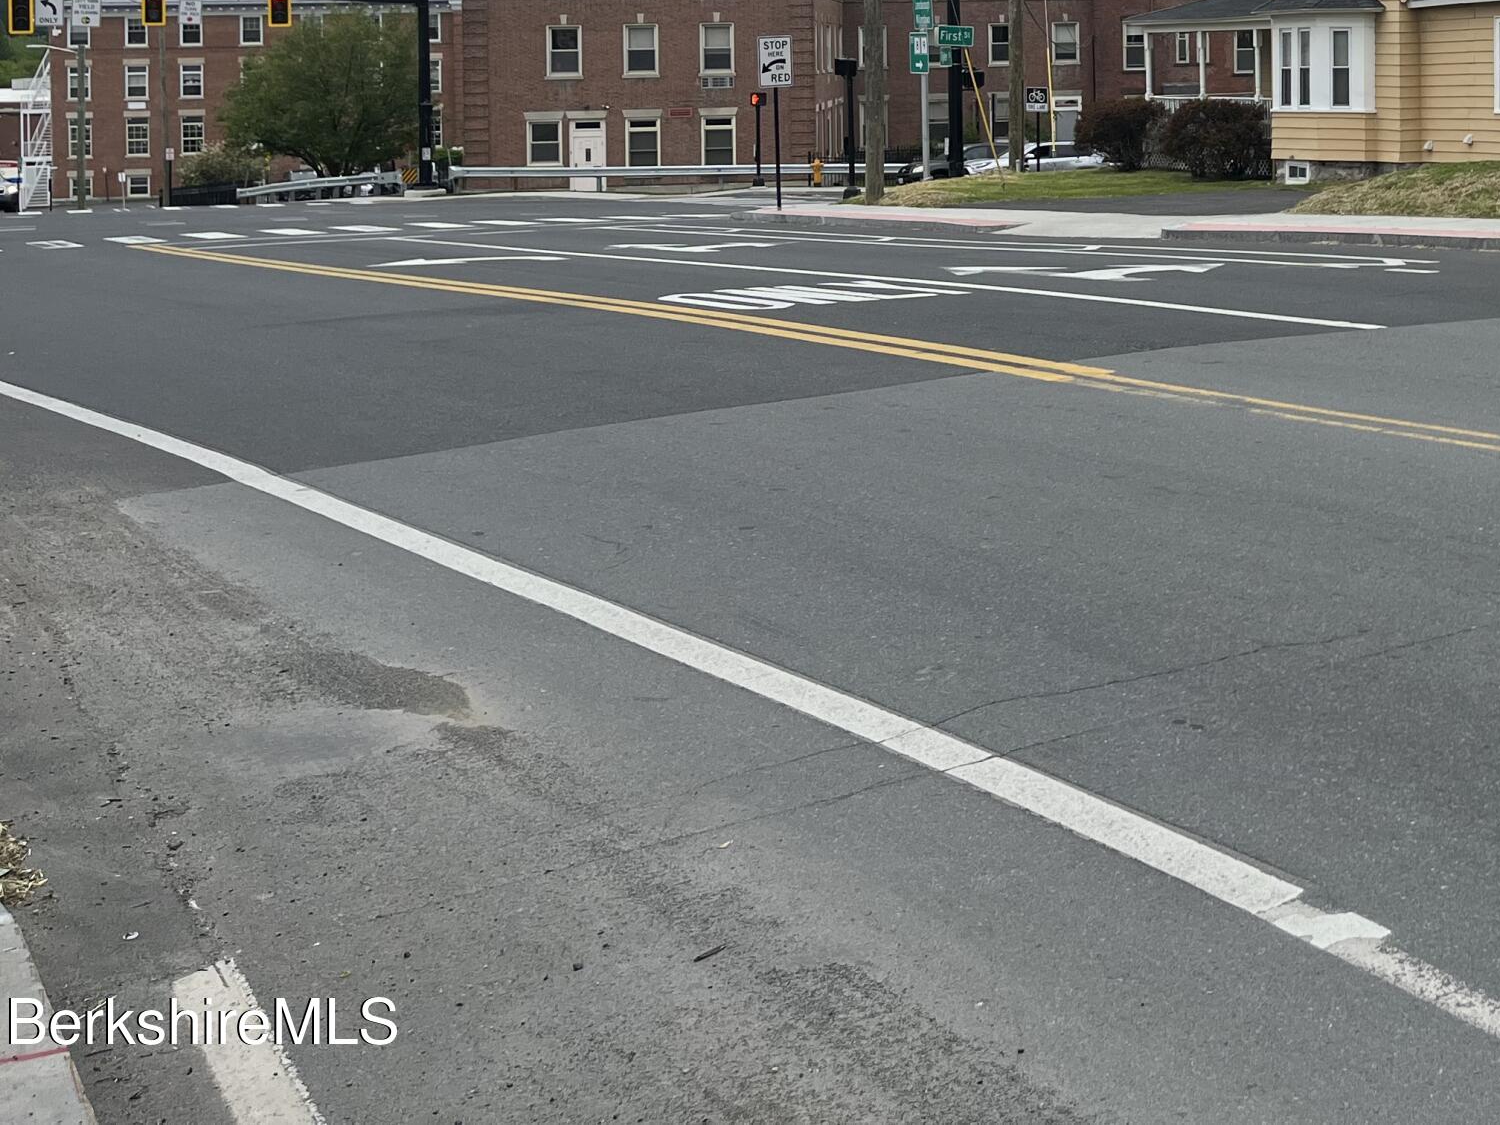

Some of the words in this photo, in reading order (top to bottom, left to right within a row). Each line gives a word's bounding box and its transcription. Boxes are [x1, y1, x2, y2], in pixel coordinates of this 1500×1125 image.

[940, 29, 962, 42] First
[763, 40, 788, 50] STOP
[771, 73, 791, 83] RED
[657, 280, 973, 310] ONLY
